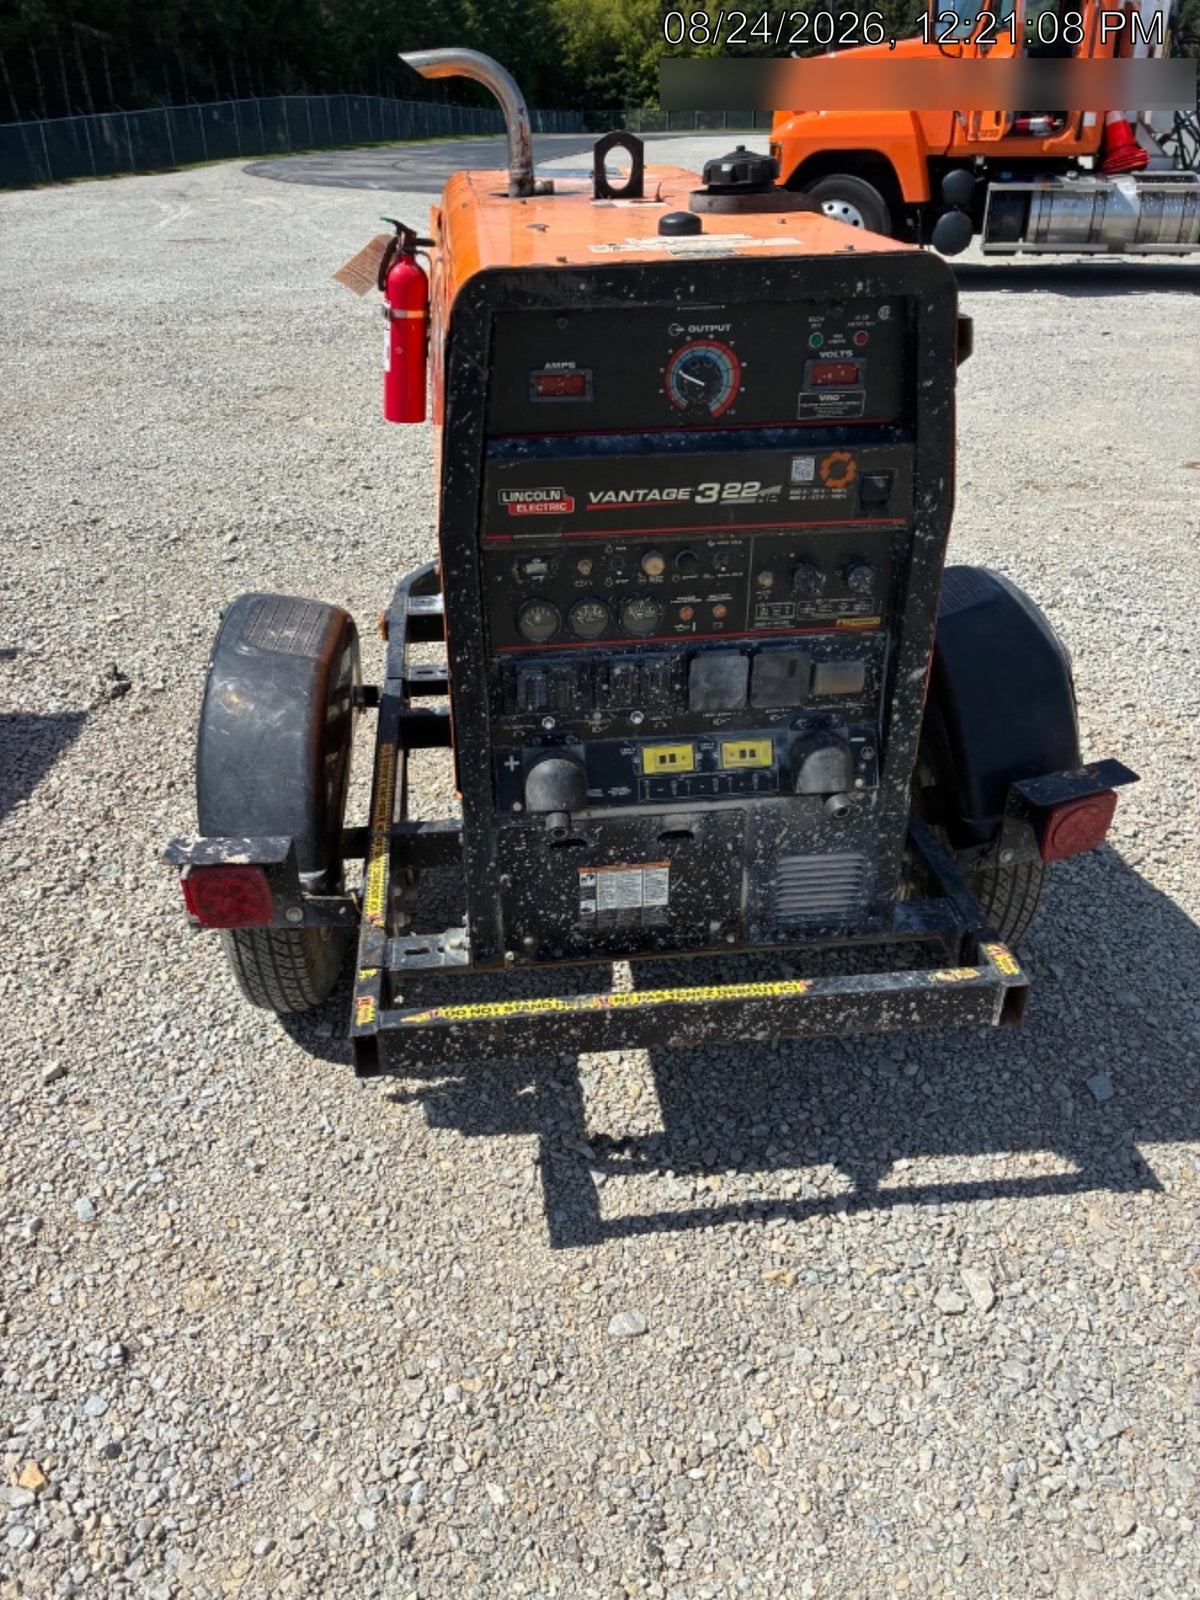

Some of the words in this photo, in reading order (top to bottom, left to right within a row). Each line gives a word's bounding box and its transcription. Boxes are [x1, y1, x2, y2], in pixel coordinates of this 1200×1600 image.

[687, 324, 732, 333] OUTPUT
[819, 349, 854, 358] VOLTS
[544, 361, 577, 369] AMPS
[502, 490, 561, 502] LINCOLN
[588, 487, 692, 504] VANTAGE
[694, 481, 762, 504] 322
[516, 502, 568, 513] ELECTRIC
